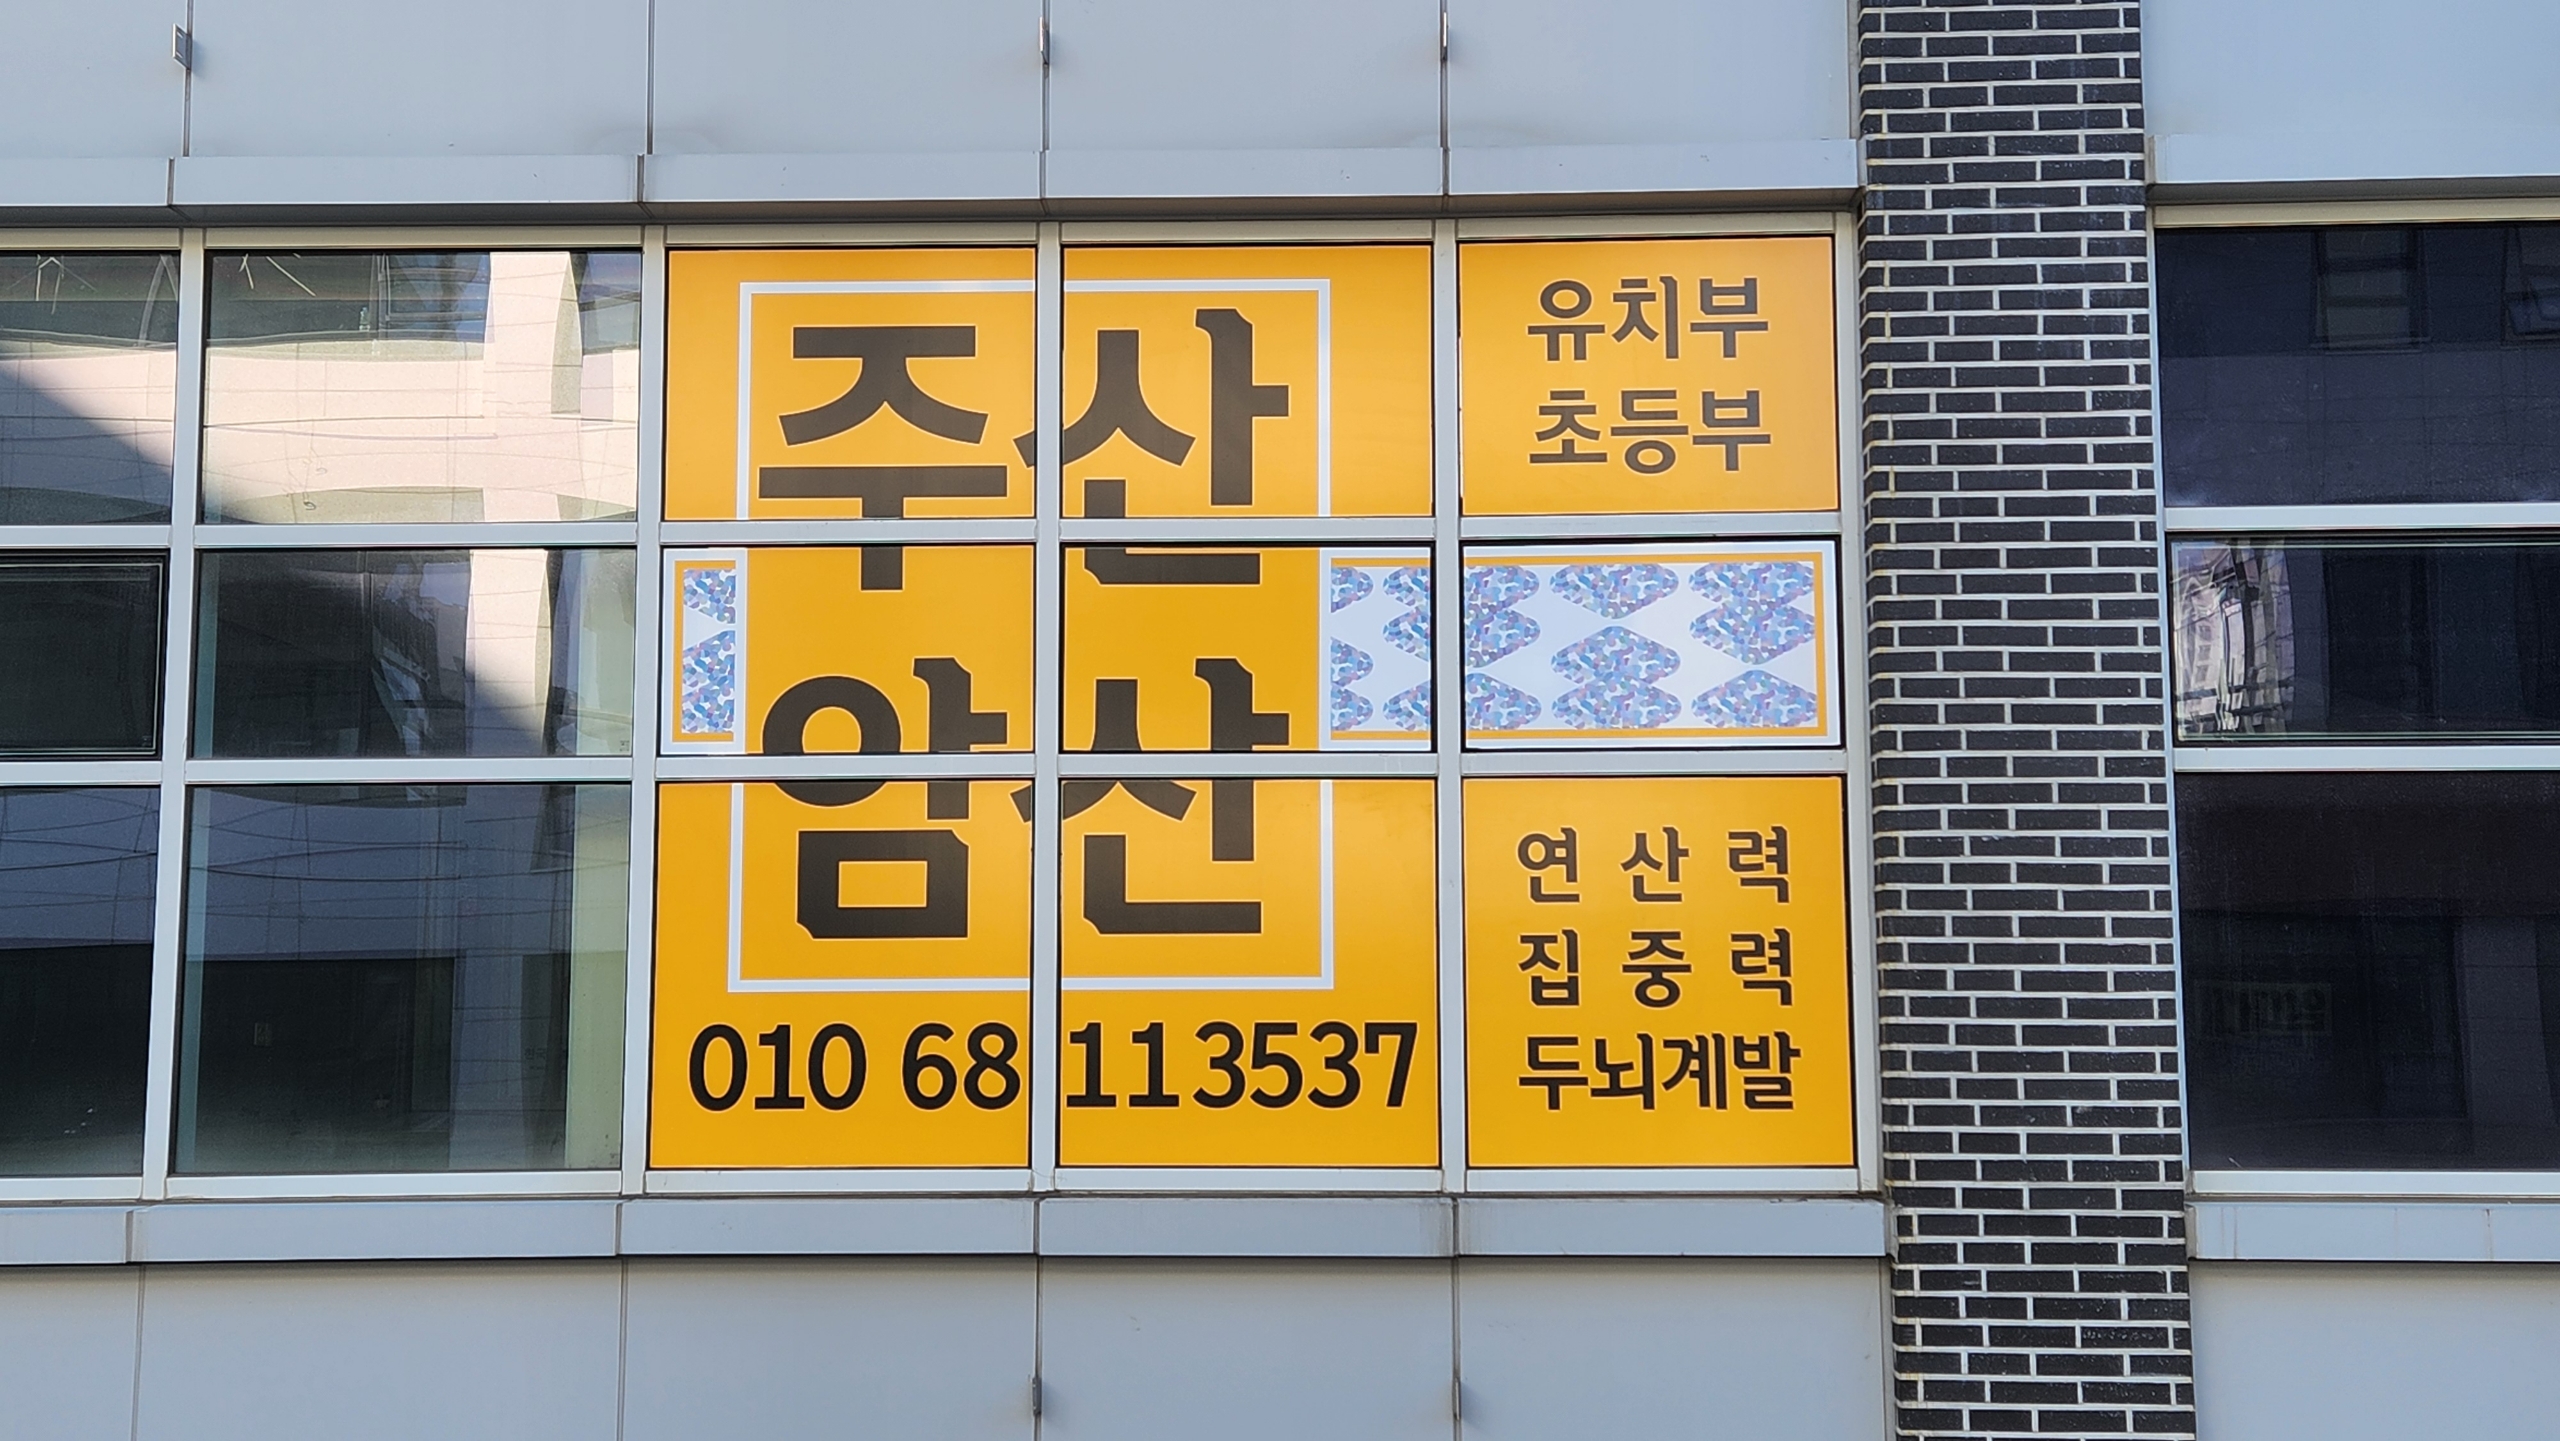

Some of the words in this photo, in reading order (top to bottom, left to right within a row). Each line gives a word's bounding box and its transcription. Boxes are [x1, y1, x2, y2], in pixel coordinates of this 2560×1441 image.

[1528, 276, 1768, 361] 유치부
[759, 308, 1289, 591] 주산
[1530, 390, 1771, 474] 초등부
[762, 657, 1289, 939] 암산
[689, 1023, 867, 1111] 010
[1519, 1031, 1801, 1111] 두뇌계발
